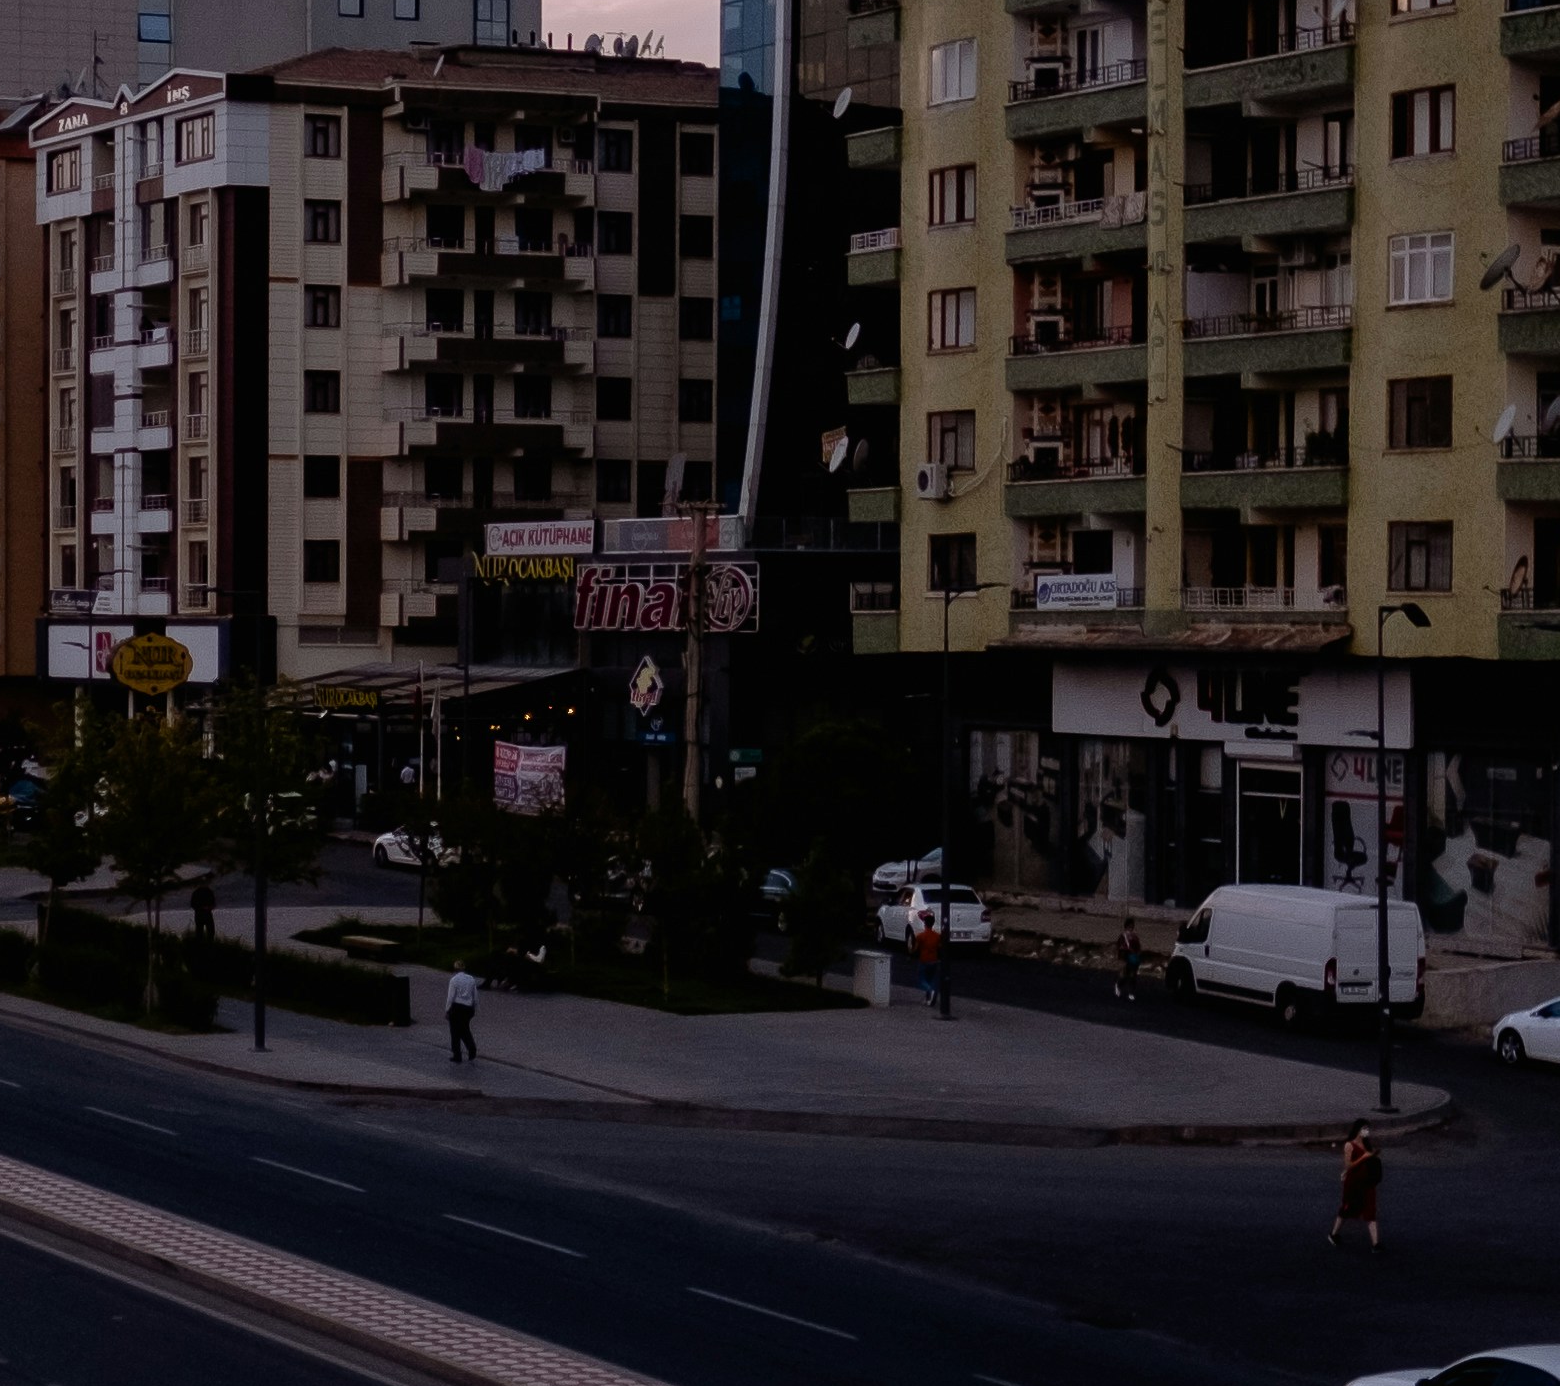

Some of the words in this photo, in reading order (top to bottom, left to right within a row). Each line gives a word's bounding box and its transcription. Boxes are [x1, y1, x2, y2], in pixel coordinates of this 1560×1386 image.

[58, 113, 89, 133] ZANA
[502, 528, 525, 551] AÇIK
[527, 524, 593, 547] KÜTÜPHANE
[508, 556, 575, 584] OCAKBAŞI
[1353, 756, 1402, 785] 4LNE
